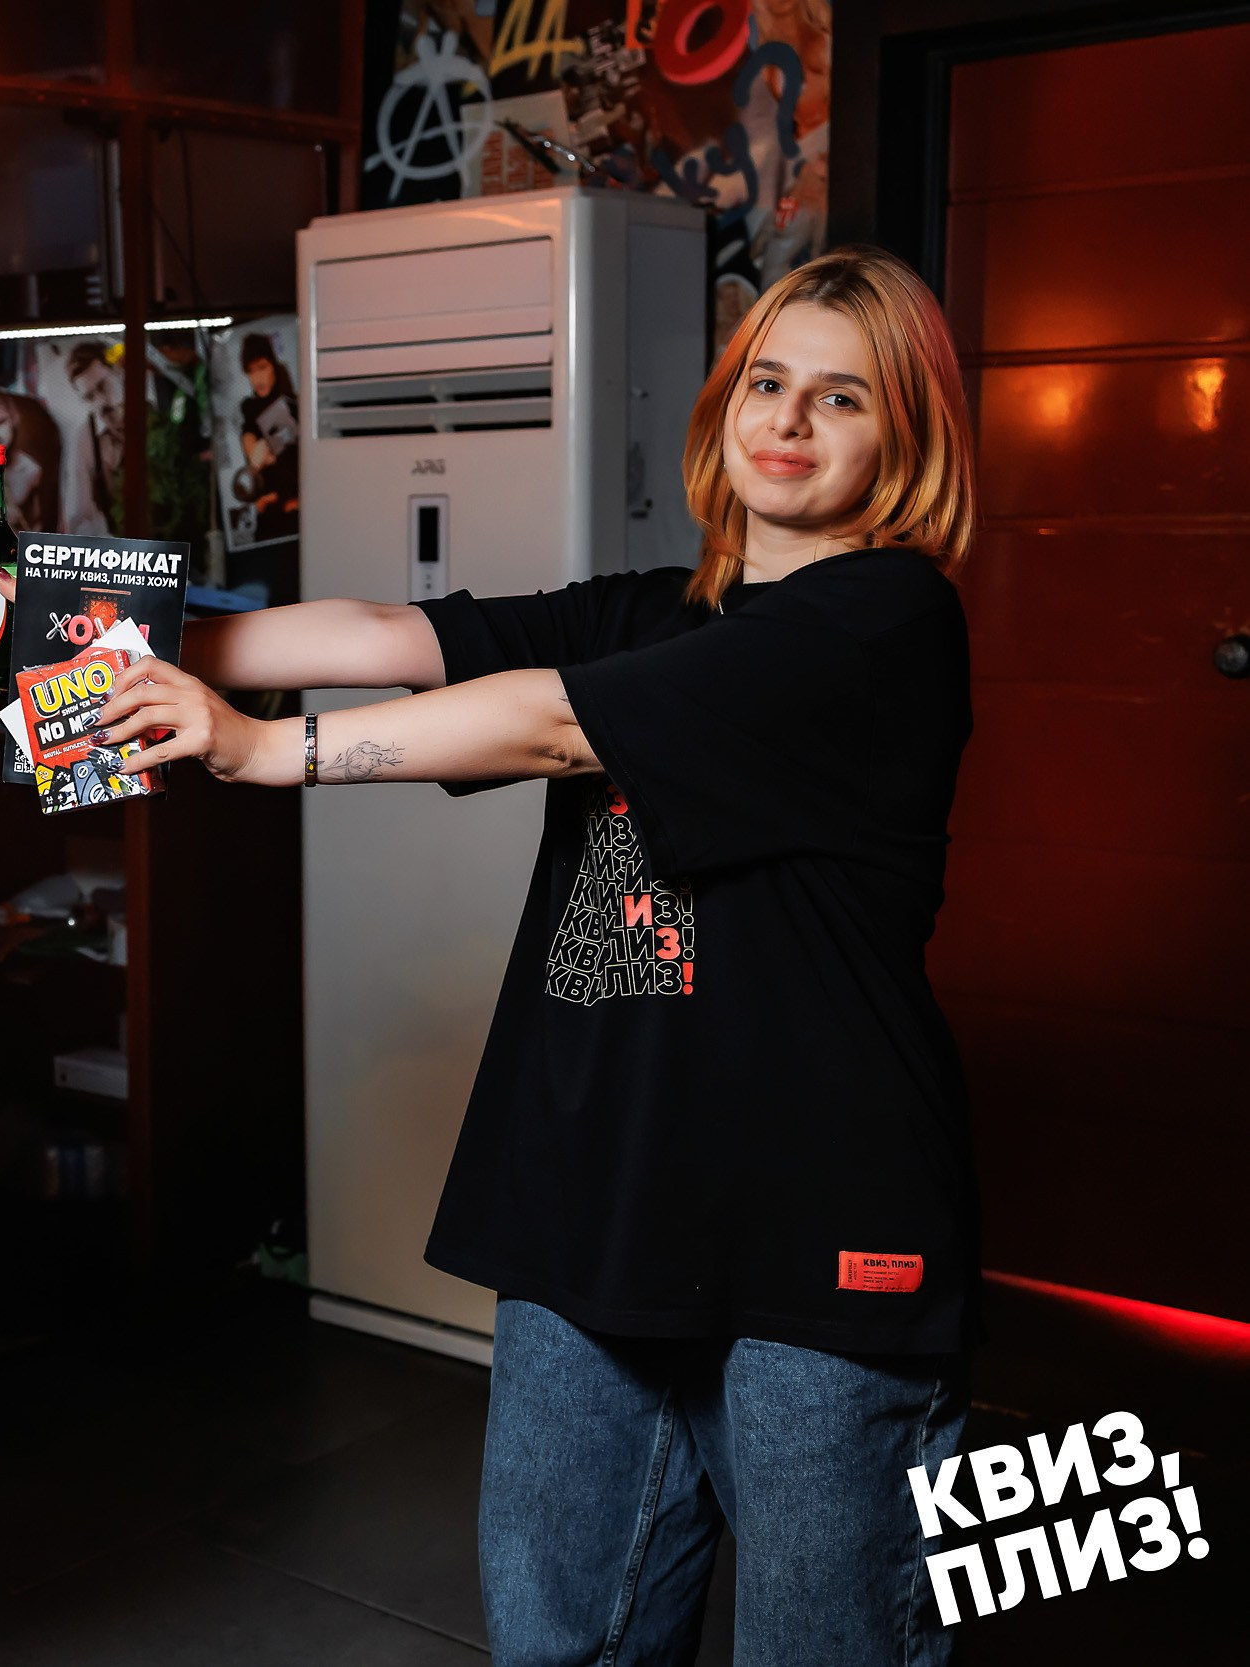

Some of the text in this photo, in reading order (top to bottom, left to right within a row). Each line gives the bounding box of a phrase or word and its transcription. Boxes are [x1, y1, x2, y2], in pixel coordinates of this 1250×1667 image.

[25, 544, 182, 574] СЕРТИФИКАТ
[25, 567, 178, 588] НА 1 ИГРУ КВИЗ, ПЛИЗ! ХОУМ
[31, 660, 115, 718] UNO
[61, 704, 79, 717] SHOW
[38, 721, 66, 745] NO
[863, 1258, 917, 1269] КВИЗ, ПЛИЗ!
